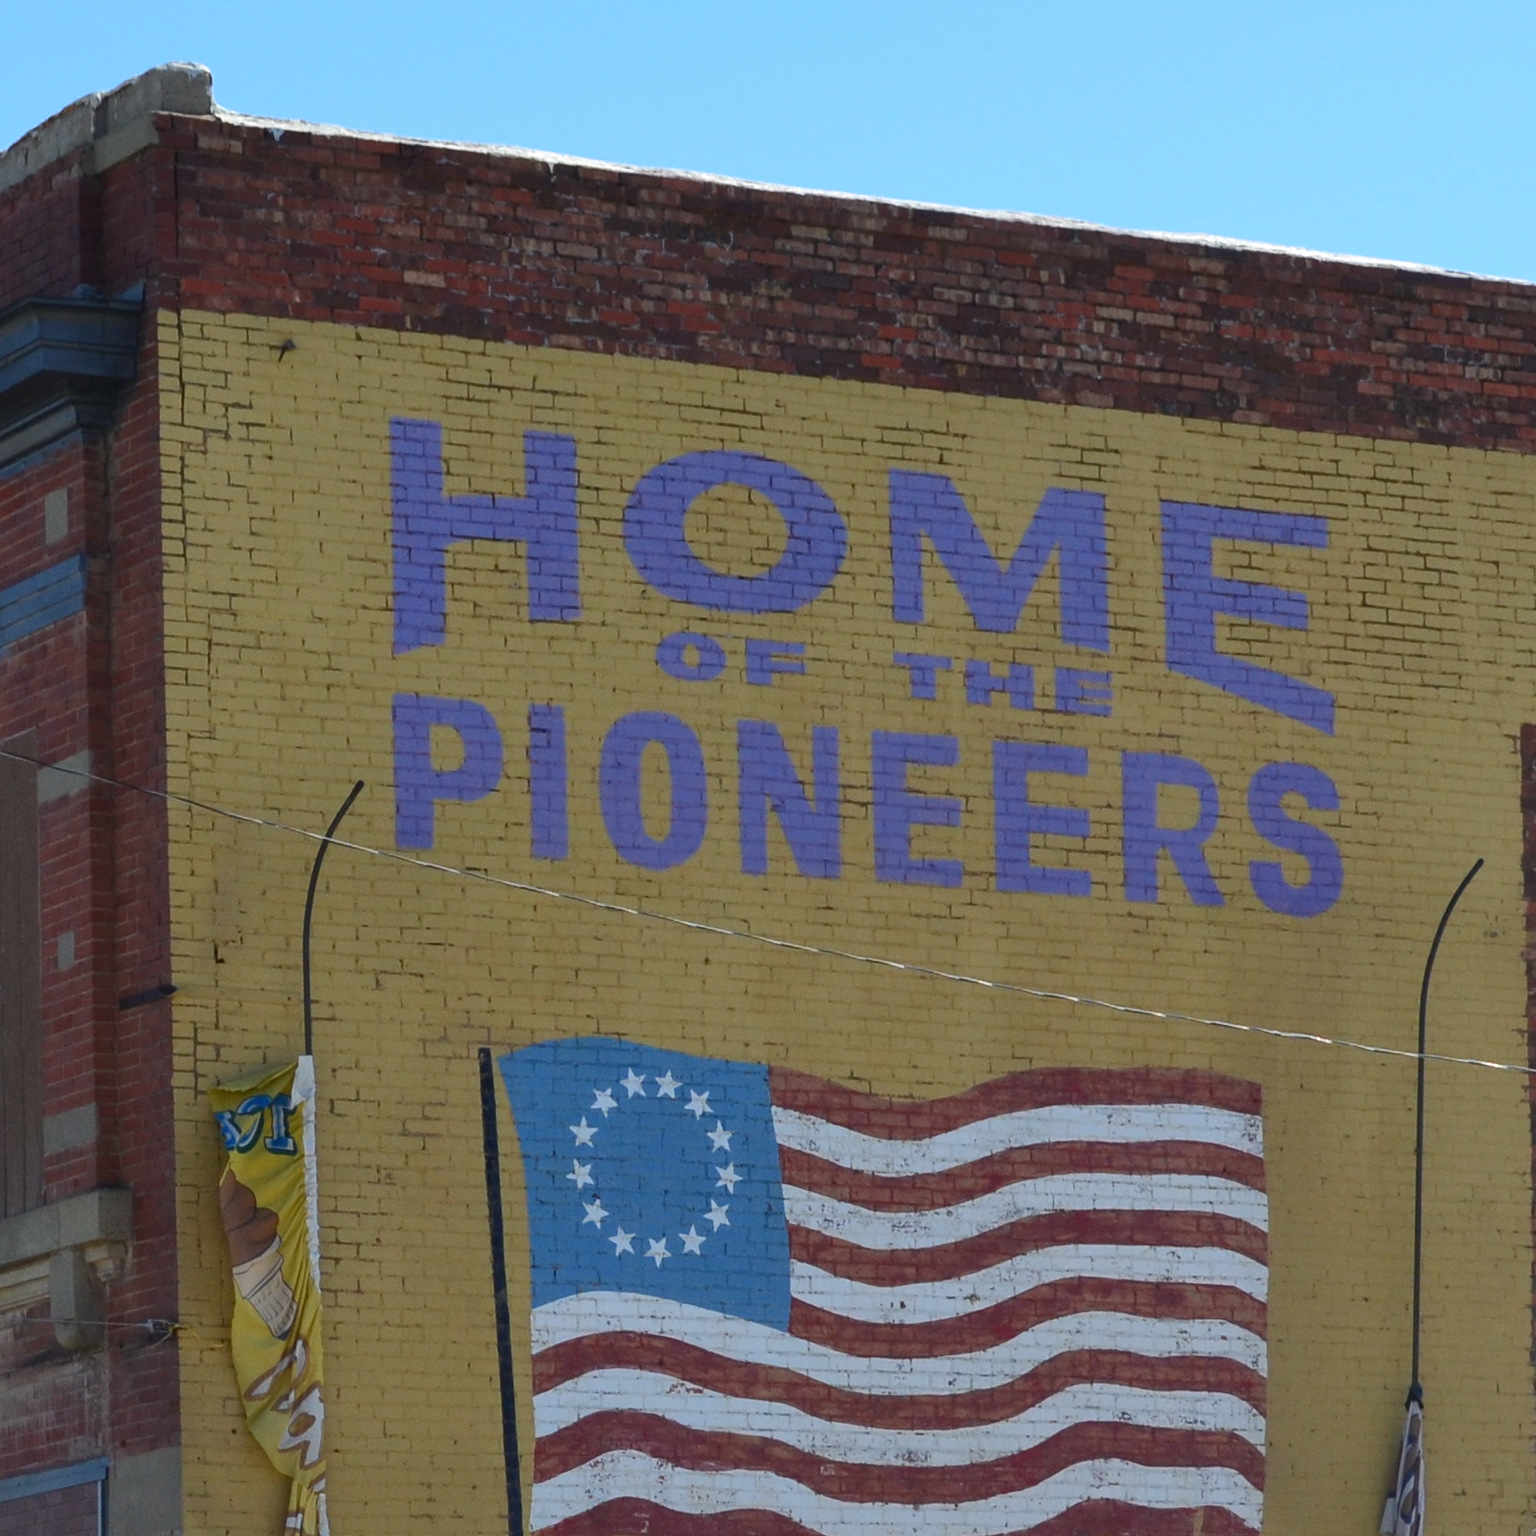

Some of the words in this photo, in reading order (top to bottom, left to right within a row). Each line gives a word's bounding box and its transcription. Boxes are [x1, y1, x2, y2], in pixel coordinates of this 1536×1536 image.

[390, 416, 1336, 735] HOME
[655, 631, 807, 686] OF
[893, 651, 1113, 717] THE
[392, 692, 1344, 918] PIONEERS
